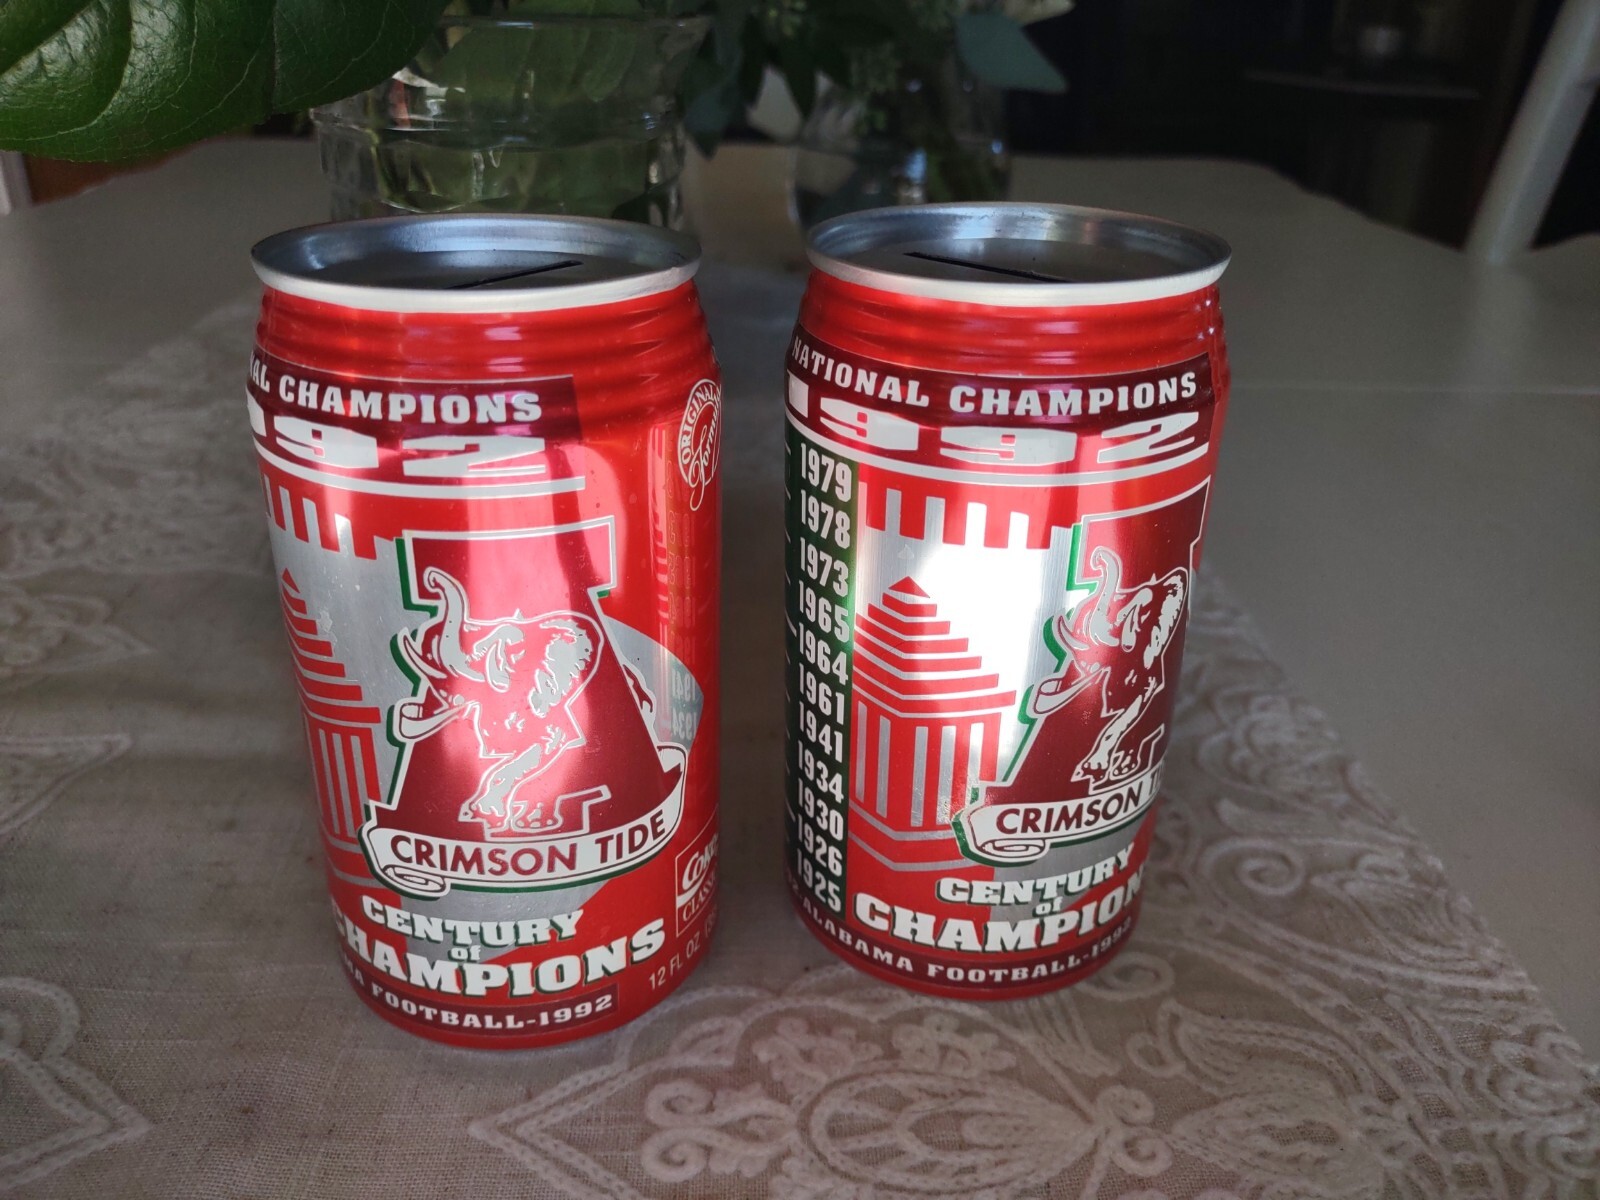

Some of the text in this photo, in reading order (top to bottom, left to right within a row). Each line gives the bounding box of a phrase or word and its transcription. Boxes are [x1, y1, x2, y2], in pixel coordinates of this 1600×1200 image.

[279, 374, 543, 424] CHAMPIONS
[792, 336, 1197, 418] NATIONAL CHAMPIONS
[681, 384, 716, 465] ORIGINAL
[787, 369, 1199, 466] 1992
[801, 443, 852, 502] 1979
[801, 489, 850, 549] 1978
[800, 537, 849, 598] 1973
[799, 580, 850, 643] 1965
[799, 622, 848, 685] 1964
[799, 663, 845, 726] 1961
[799, 701, 843, 763] 1941
[798, 740, 844, 804] 1934
[798, 778, 843, 841] 1930
[996, 780, 1143, 834] CRIMSON
[390, 809, 666, 876] CRIMSON TIDE
[798, 814, 842, 877] 1926
[938, 842, 1134, 905] CENTURY
[797, 848, 841, 912] 1925
[1035, 898, 1061, 916] of
[331, 894, 666, 998] CHAMPIONS
[361, 894, 584, 948] CENTURY
[448, 945, 481, 963] of
[649, 932, 701, 990] 12 FL OZ
[371, 982, 613, 1030] FOOTBALL-1992
